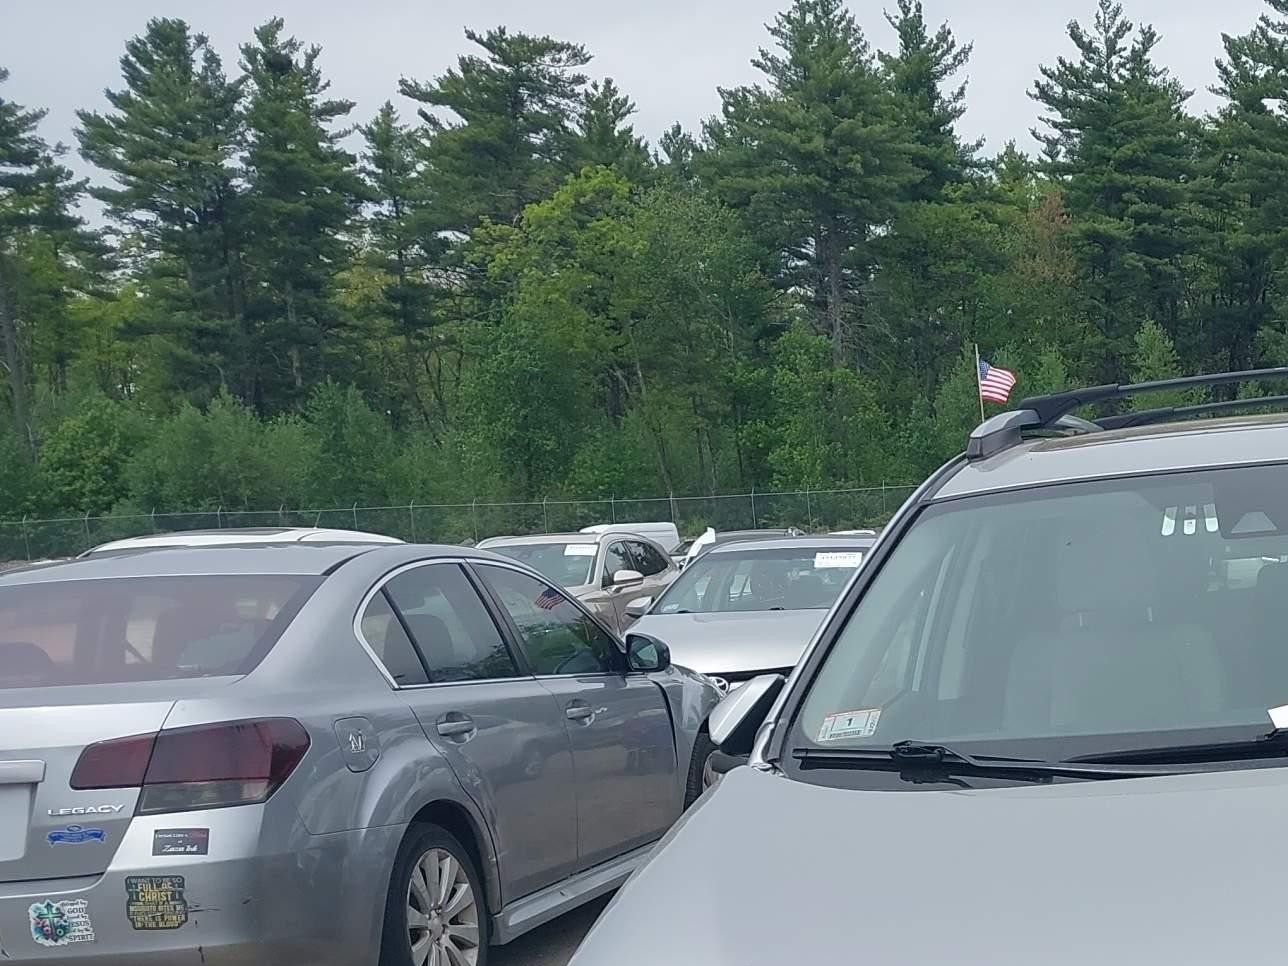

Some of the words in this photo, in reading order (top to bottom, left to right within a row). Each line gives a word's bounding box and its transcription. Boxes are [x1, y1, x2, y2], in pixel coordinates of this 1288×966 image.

[47, 804, 125, 816] LEGACY
[137, 883, 159, 892] FULL
[138, 891, 173, 902] CHRIST
